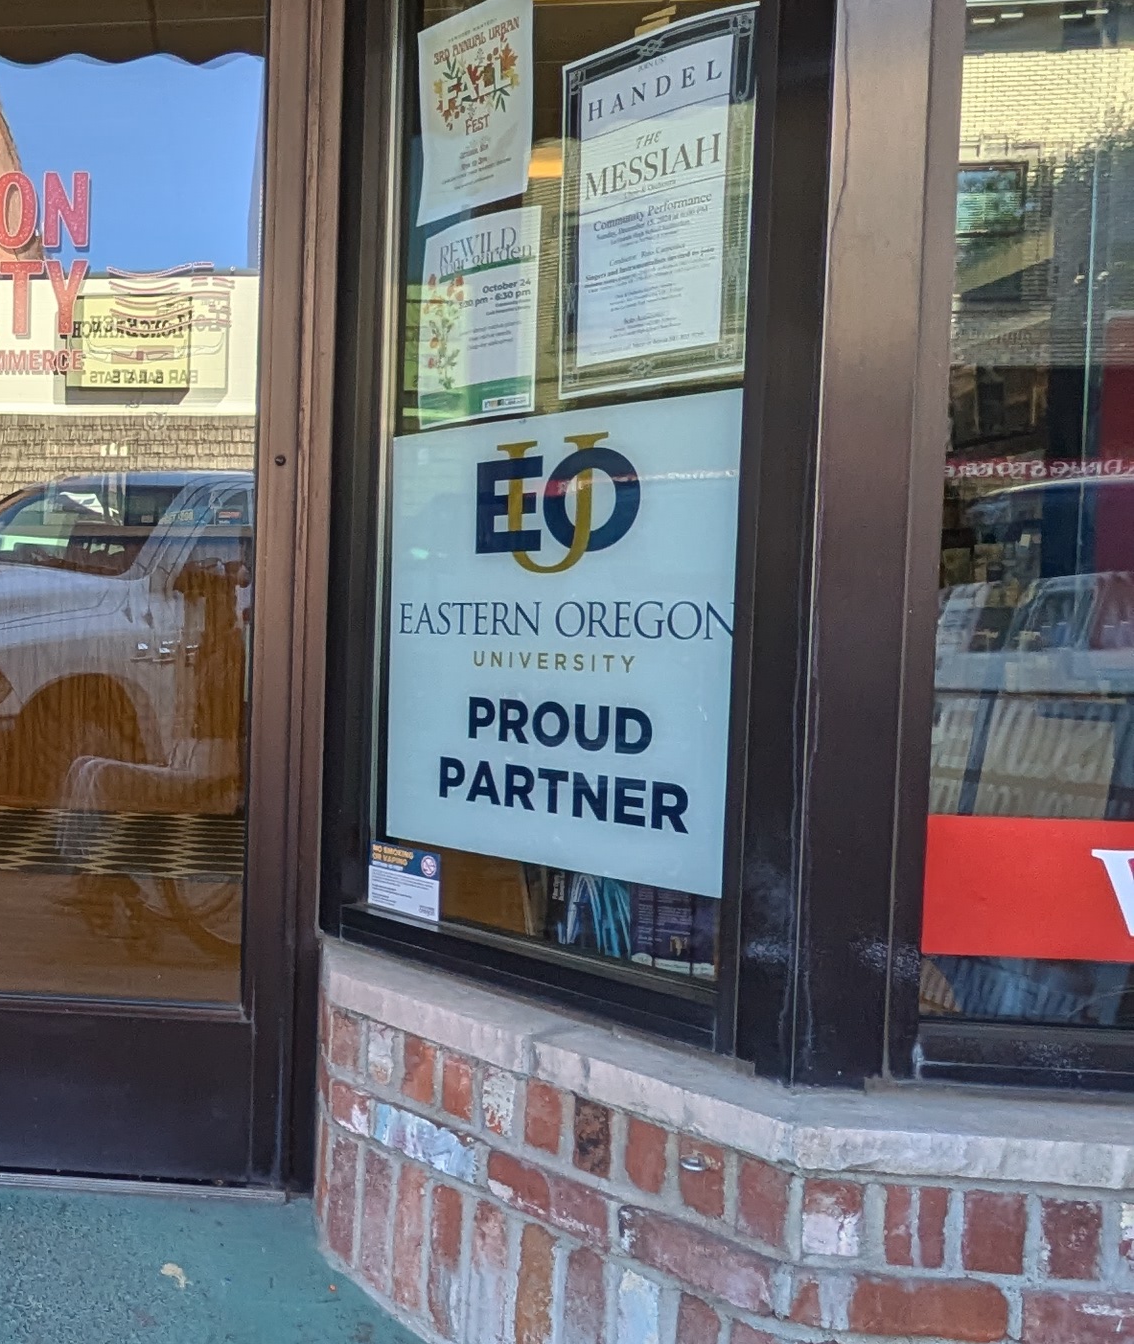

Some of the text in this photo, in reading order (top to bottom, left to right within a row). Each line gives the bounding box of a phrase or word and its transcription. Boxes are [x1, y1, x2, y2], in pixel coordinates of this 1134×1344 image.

[433, 16, 520, 65] 3RD ANNUAL URBAN
[442, 58, 511, 110] FALL
[588, 60, 723, 122] HANDEL
[465, 114, 490, 135] FEST
[635, 131, 662, 149] THE
[585, 132, 722, 200] MESSIAH
[593, 193, 713, 232] Community Performance
[439, 226, 517, 267] REWILD
[471, 242, 533, 269] garden
[475, 297, 488, 308] pm
[495, 291, 514, 301] 6:30
[515, 289, 531, 299] pm
[482, 278, 531, 294] October 24
[399, 600, 734, 642] EASTERN OREGON
[473, 651, 636, 674] UNIVERSITY
[468, 696, 653, 754] PROUD
[439, 756, 688, 834] PARTNER
[372, 843, 414, 860] NO SMOKING
[372, 852, 408, 866] OR VAPING
